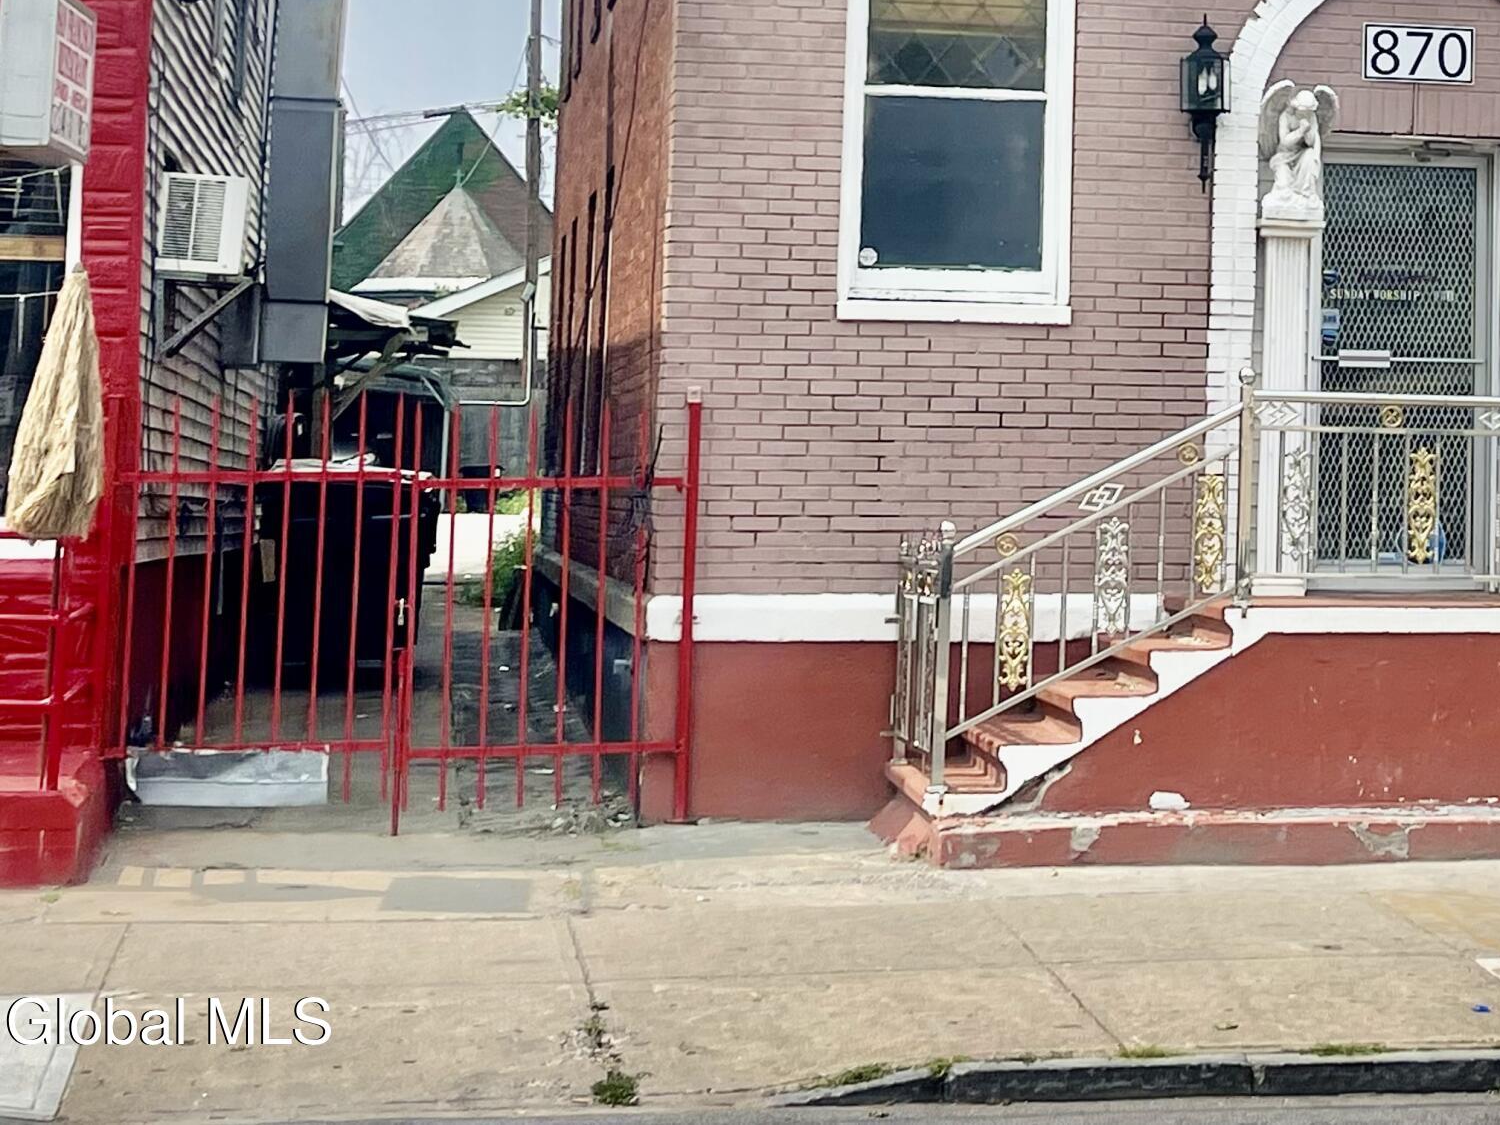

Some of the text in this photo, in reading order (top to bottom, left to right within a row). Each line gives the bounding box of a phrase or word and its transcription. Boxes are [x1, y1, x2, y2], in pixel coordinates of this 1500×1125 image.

[1370, 29, 1468, 79] 870
[1330, 289, 1370, 300] SUNDAY
[1374, 290, 1420, 301] WORSHIP
